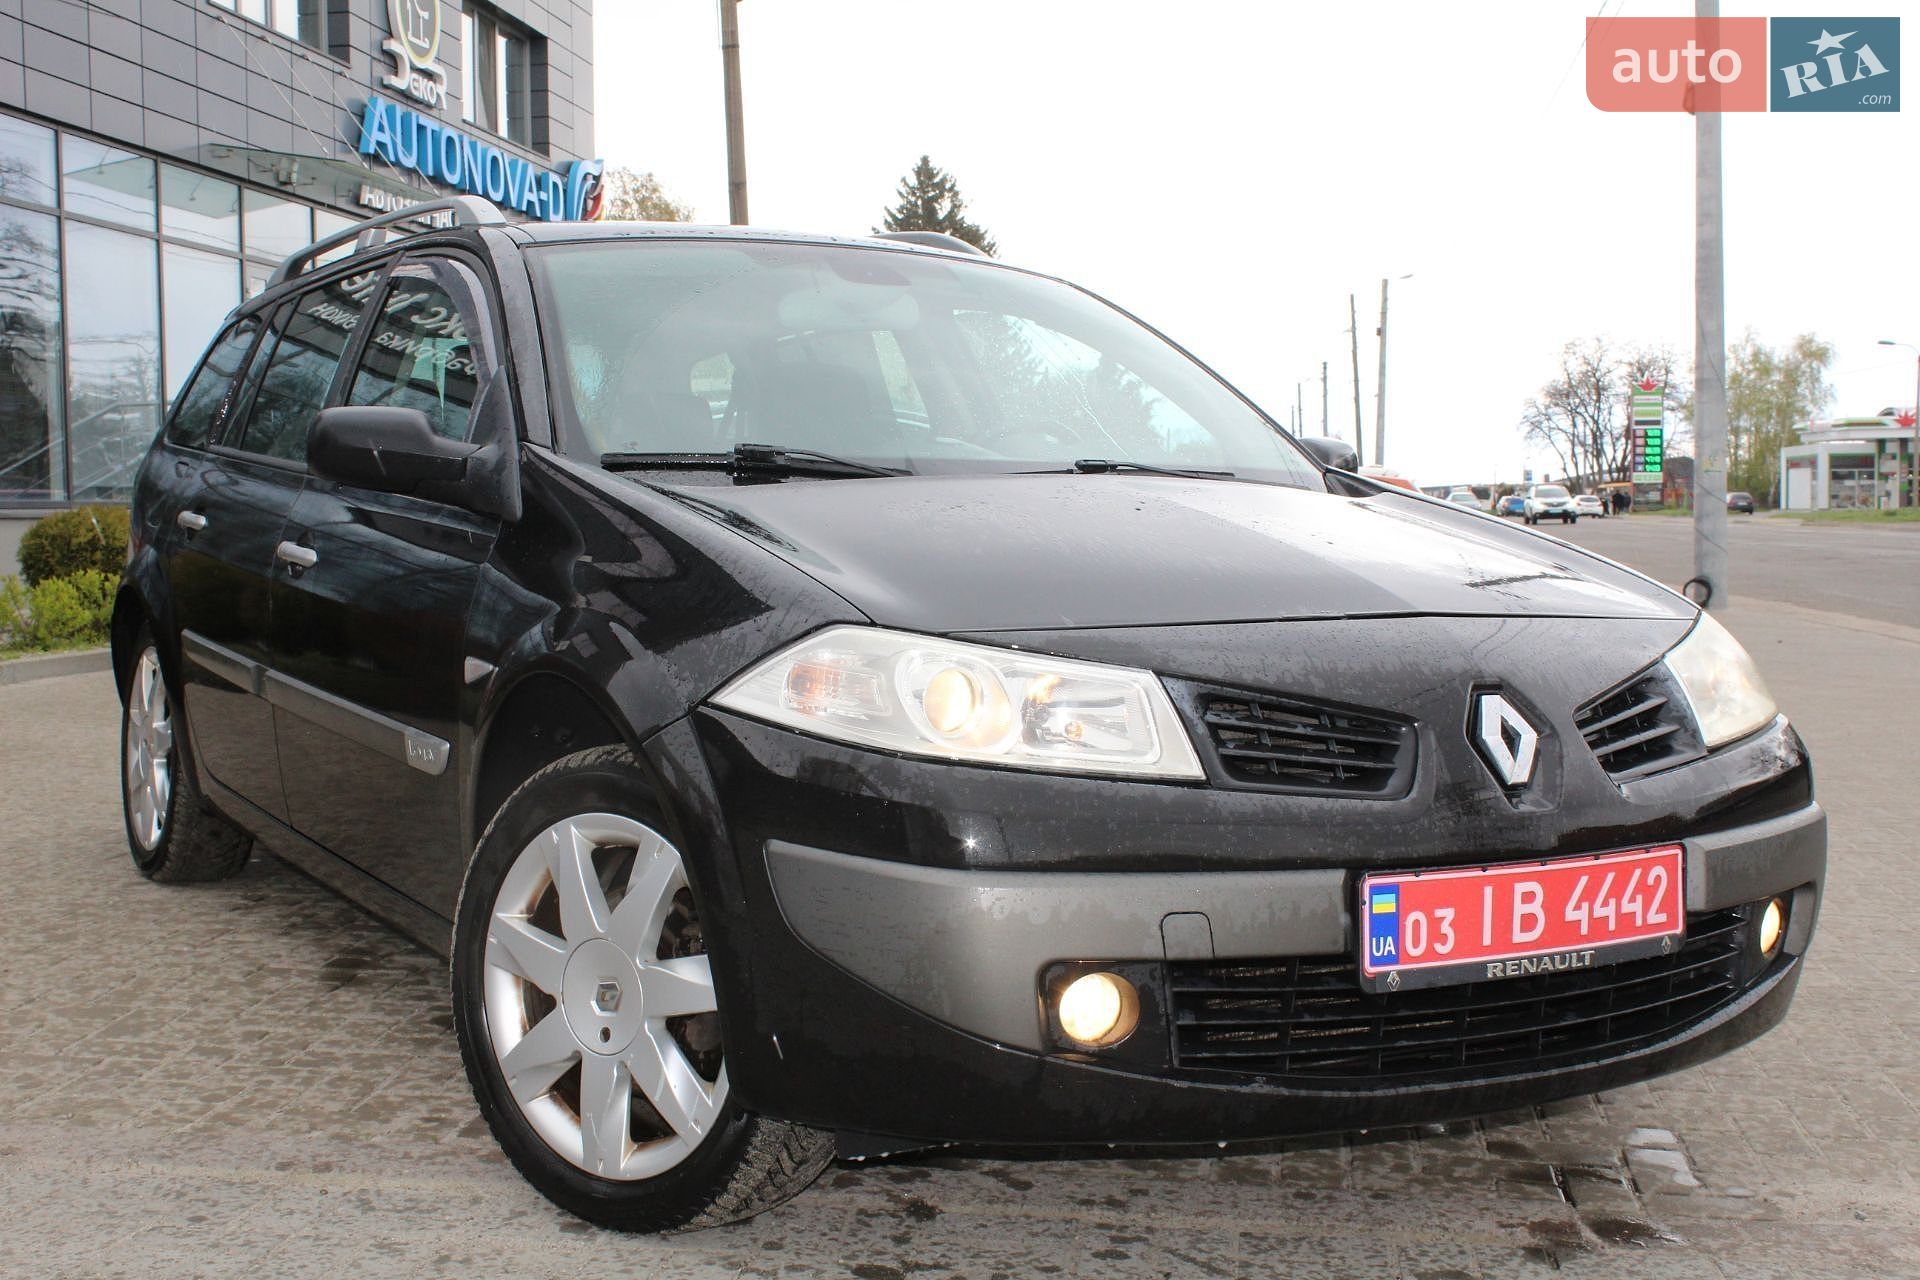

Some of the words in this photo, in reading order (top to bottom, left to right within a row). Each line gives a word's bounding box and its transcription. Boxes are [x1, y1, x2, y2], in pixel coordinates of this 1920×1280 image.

[360, 97, 565, 222] AUTONOVA-D
[1404, 908, 1456, 957] 03
[1565, 865, 1669, 936] 4442
[1372, 937, 1396, 957] UA
[1487, 950, 1595, 978] RENAULT
